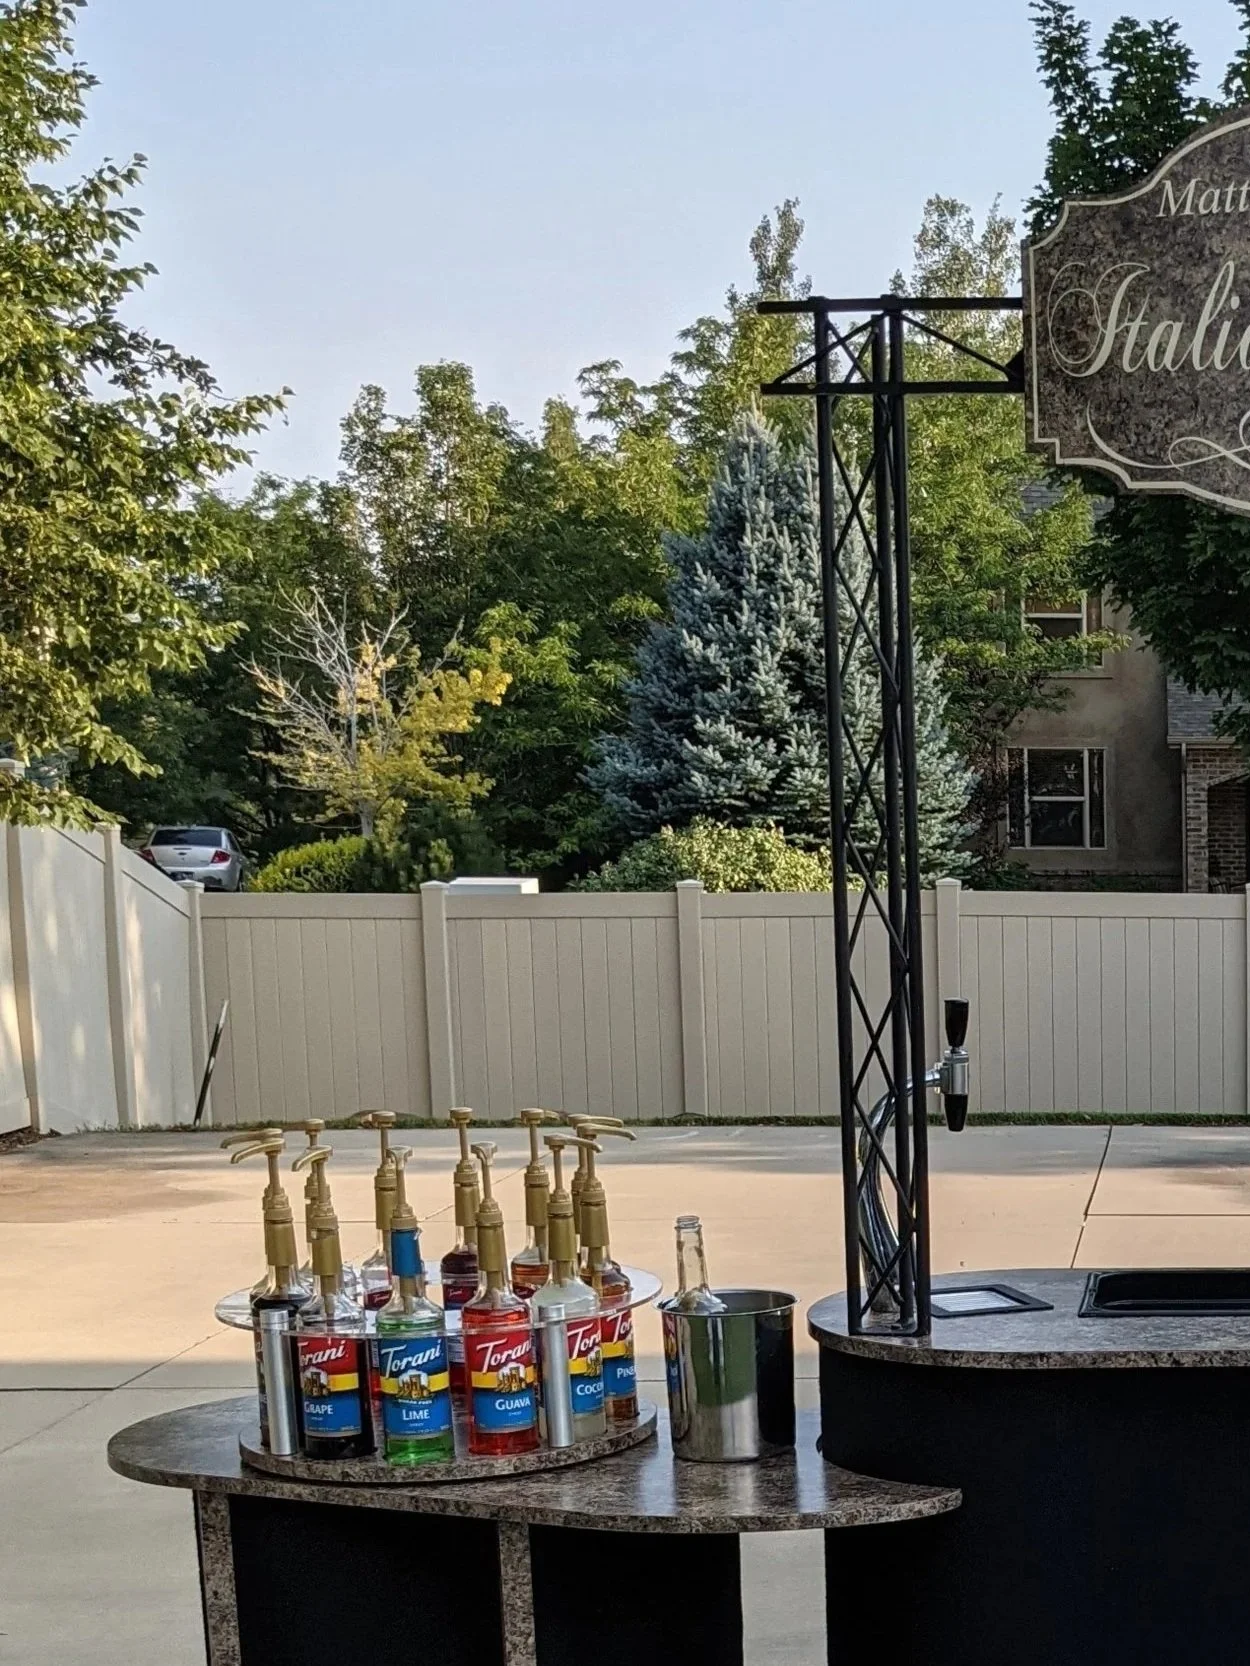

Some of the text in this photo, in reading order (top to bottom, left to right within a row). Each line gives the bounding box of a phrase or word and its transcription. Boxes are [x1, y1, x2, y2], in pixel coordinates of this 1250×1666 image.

[381, 1338, 442, 1378] Torani
[304, 1401, 334, 1415] GRAPE
[495, 1397, 531, 1411] GUAVA
[402, 1409, 431, 1421] LIME
